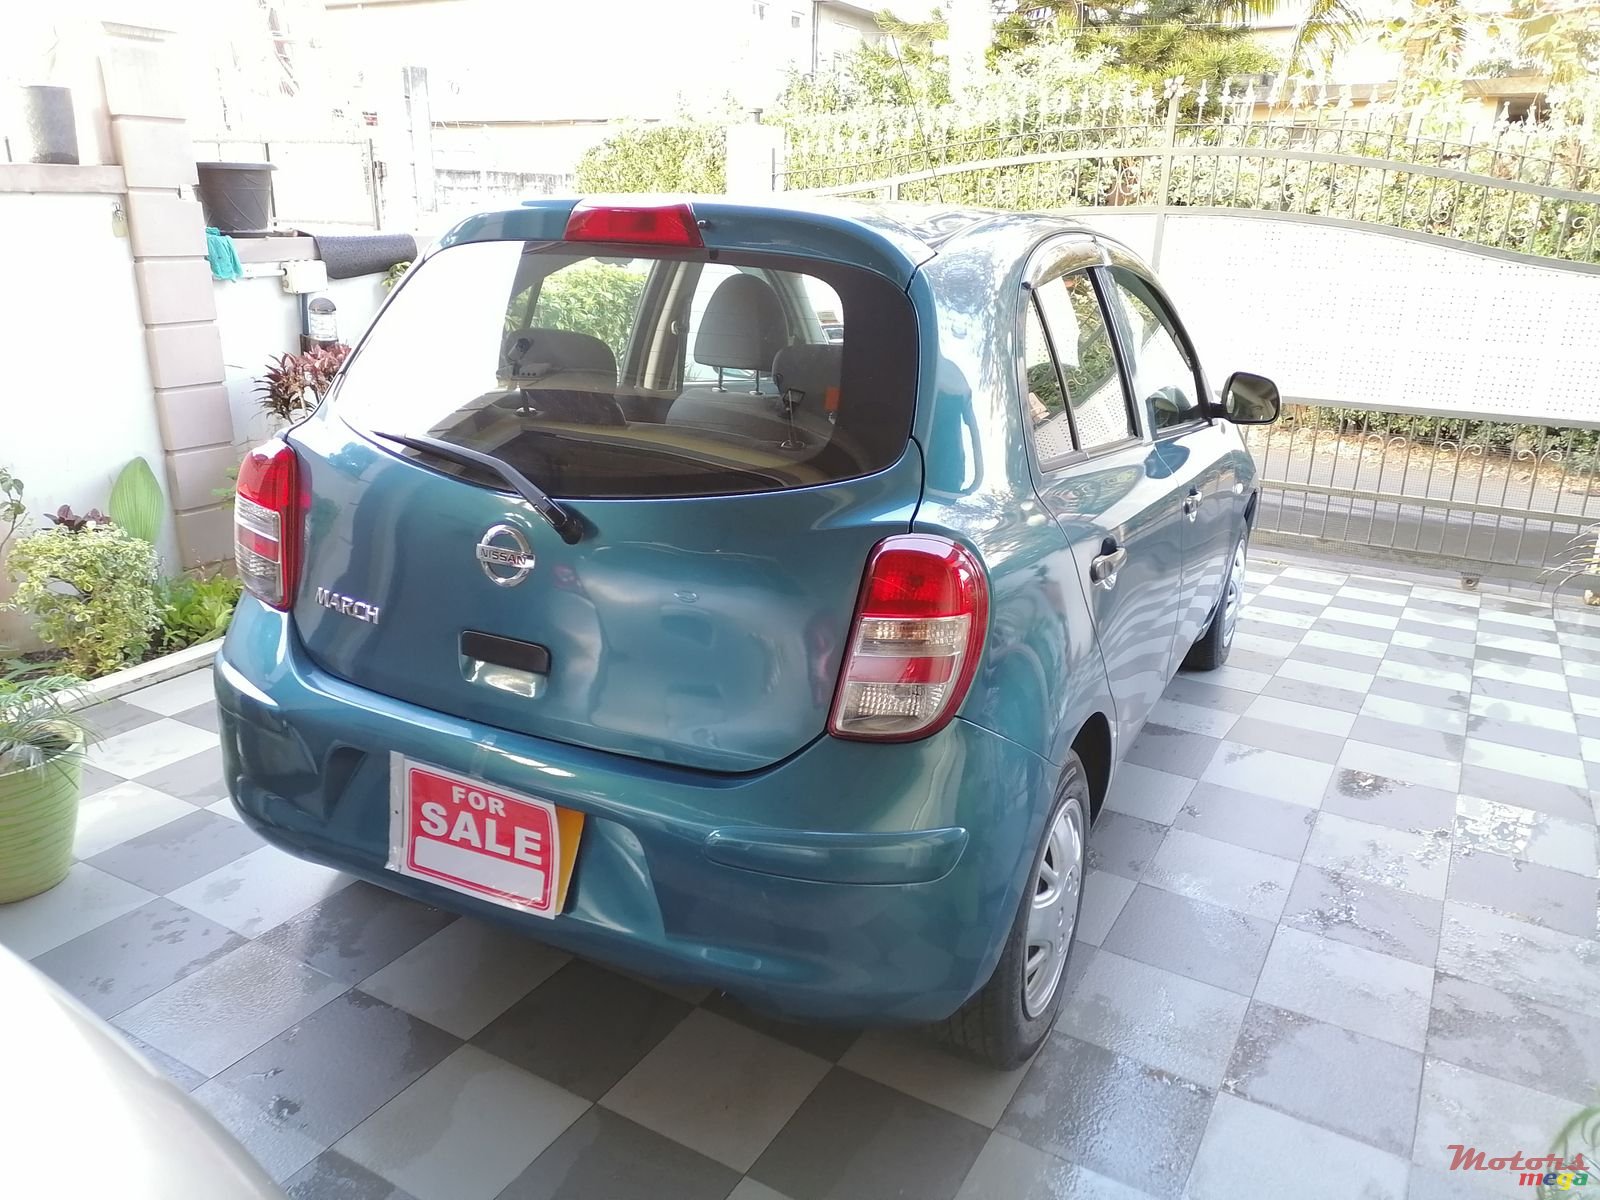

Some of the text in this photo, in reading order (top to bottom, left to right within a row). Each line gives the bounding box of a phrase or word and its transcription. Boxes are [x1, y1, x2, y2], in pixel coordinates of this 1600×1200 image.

[480, 548, 527, 566] NISSAN
[315, 587, 379, 624] MARCH
[452, 786, 506, 817] FOR
[420, 802, 542, 865] SALE
